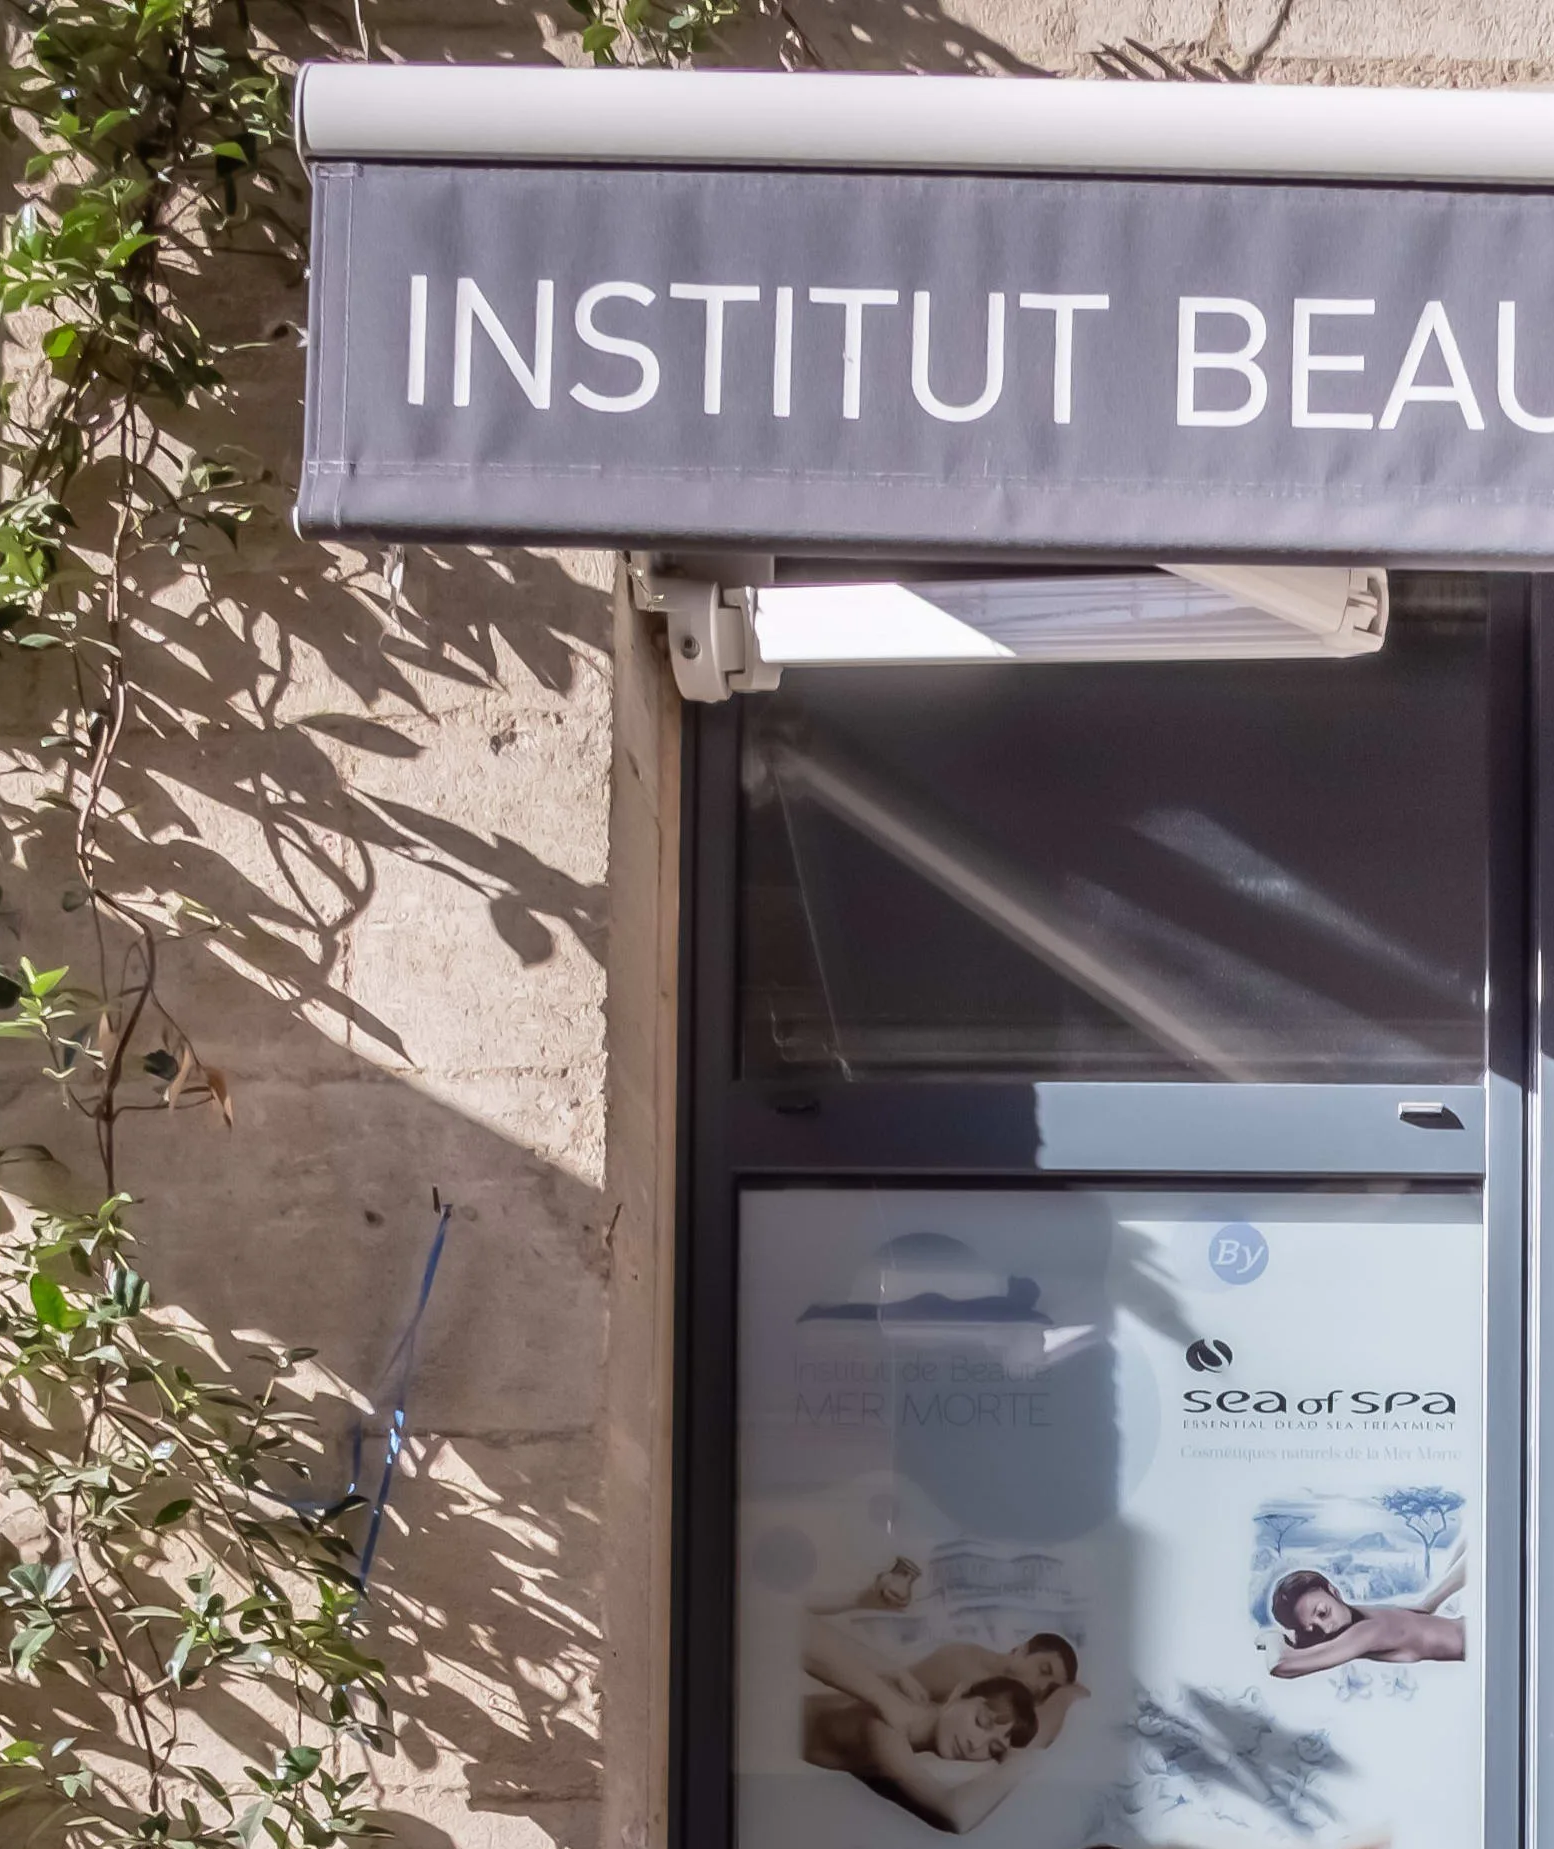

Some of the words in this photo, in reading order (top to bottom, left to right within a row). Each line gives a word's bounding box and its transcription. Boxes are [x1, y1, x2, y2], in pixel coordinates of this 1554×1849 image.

[408, 272, 1109, 426] INSTITUT
[1217, 1238, 1265, 1280] By
[794, 1391, 886, 1428] MER
[901, 1391, 1054, 1428] MORTE
[1274, 1419, 1319, 1431] DEAD
[1326, 1420, 1354, 1431] SEA
[1363, 1420, 1456, 1432] TREATMENT
